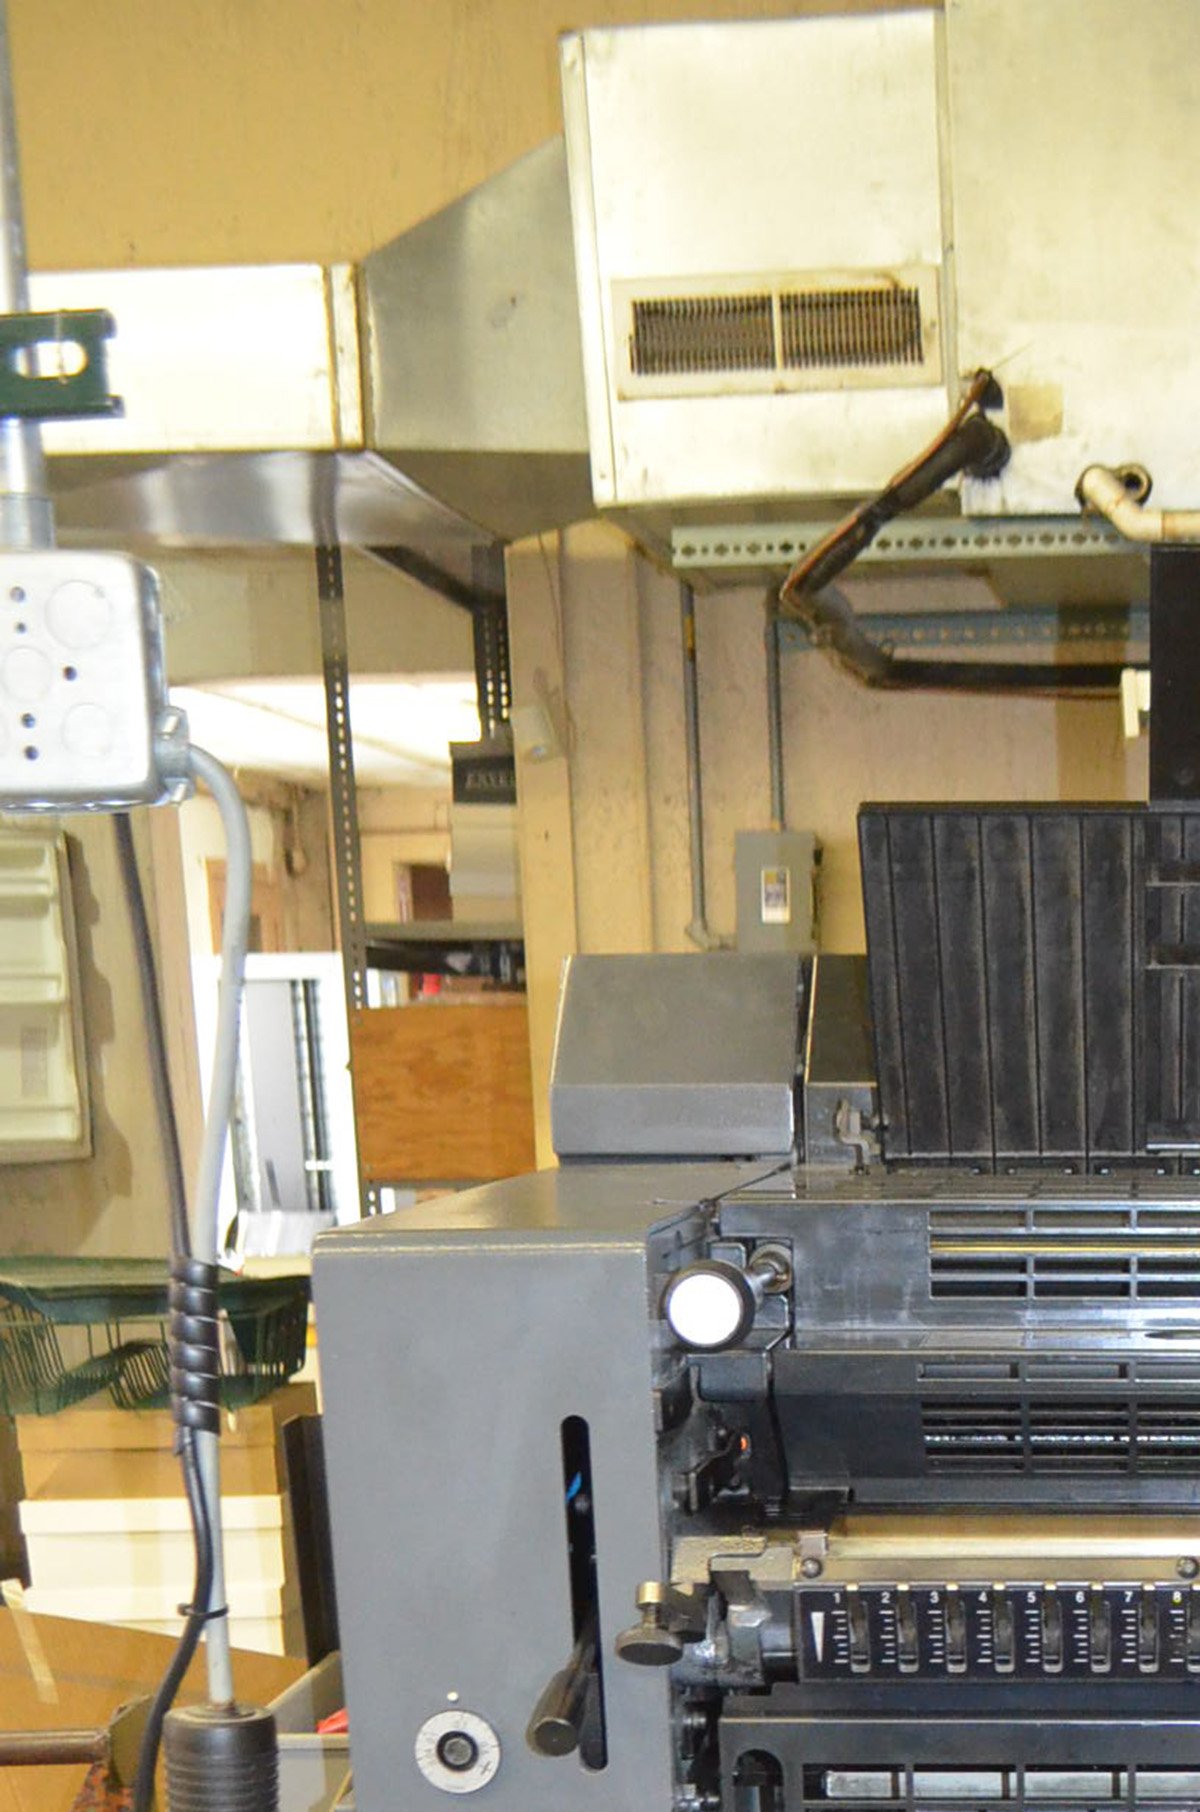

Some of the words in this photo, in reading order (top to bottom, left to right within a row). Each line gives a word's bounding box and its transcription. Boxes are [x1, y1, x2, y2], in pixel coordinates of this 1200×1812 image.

[833, 1591, 841, 1604] 1
[881, 1591, 890, 1604] 2
[930, 1591, 939, 1604] 3
[978, 1591, 988, 1604] 4
[1027, 1591, 1037, 1604] 5
[1075, 1591, 1085, 1604] 6
[1124, 1591, 1134, 1604] 7
[1173, 1591, 1182, 1604] 8
